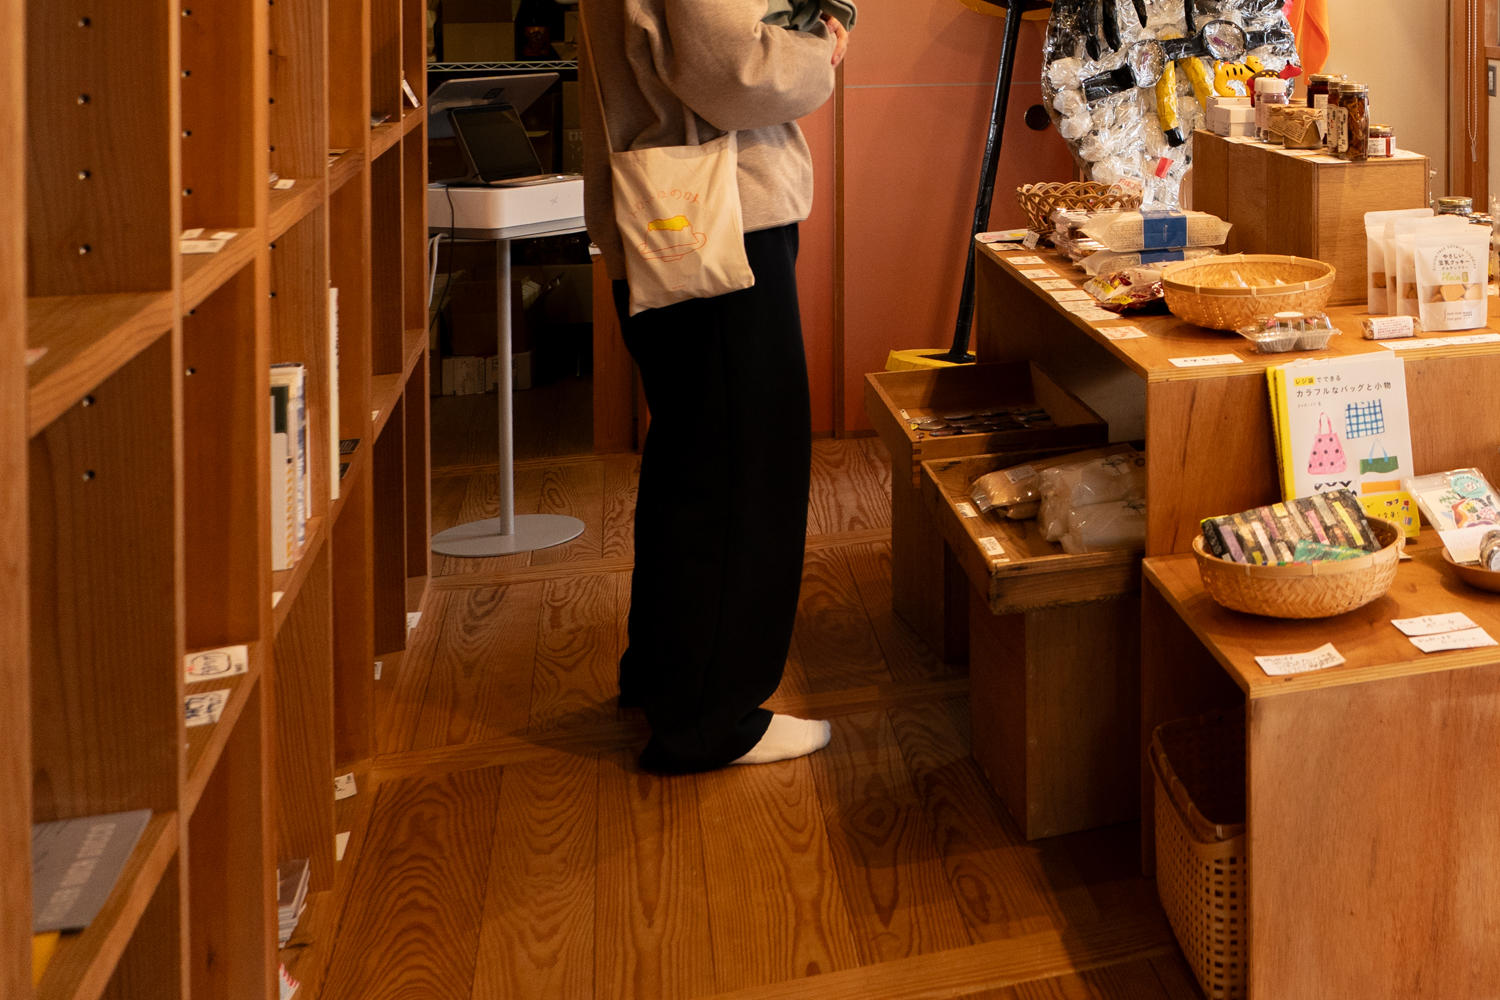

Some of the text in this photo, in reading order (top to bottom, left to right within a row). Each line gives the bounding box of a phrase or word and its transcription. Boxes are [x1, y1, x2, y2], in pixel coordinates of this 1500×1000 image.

[1441, 272, 1462, 281] Plain
[1296, 381, 1391, 398] カラフルなバッグと小物
